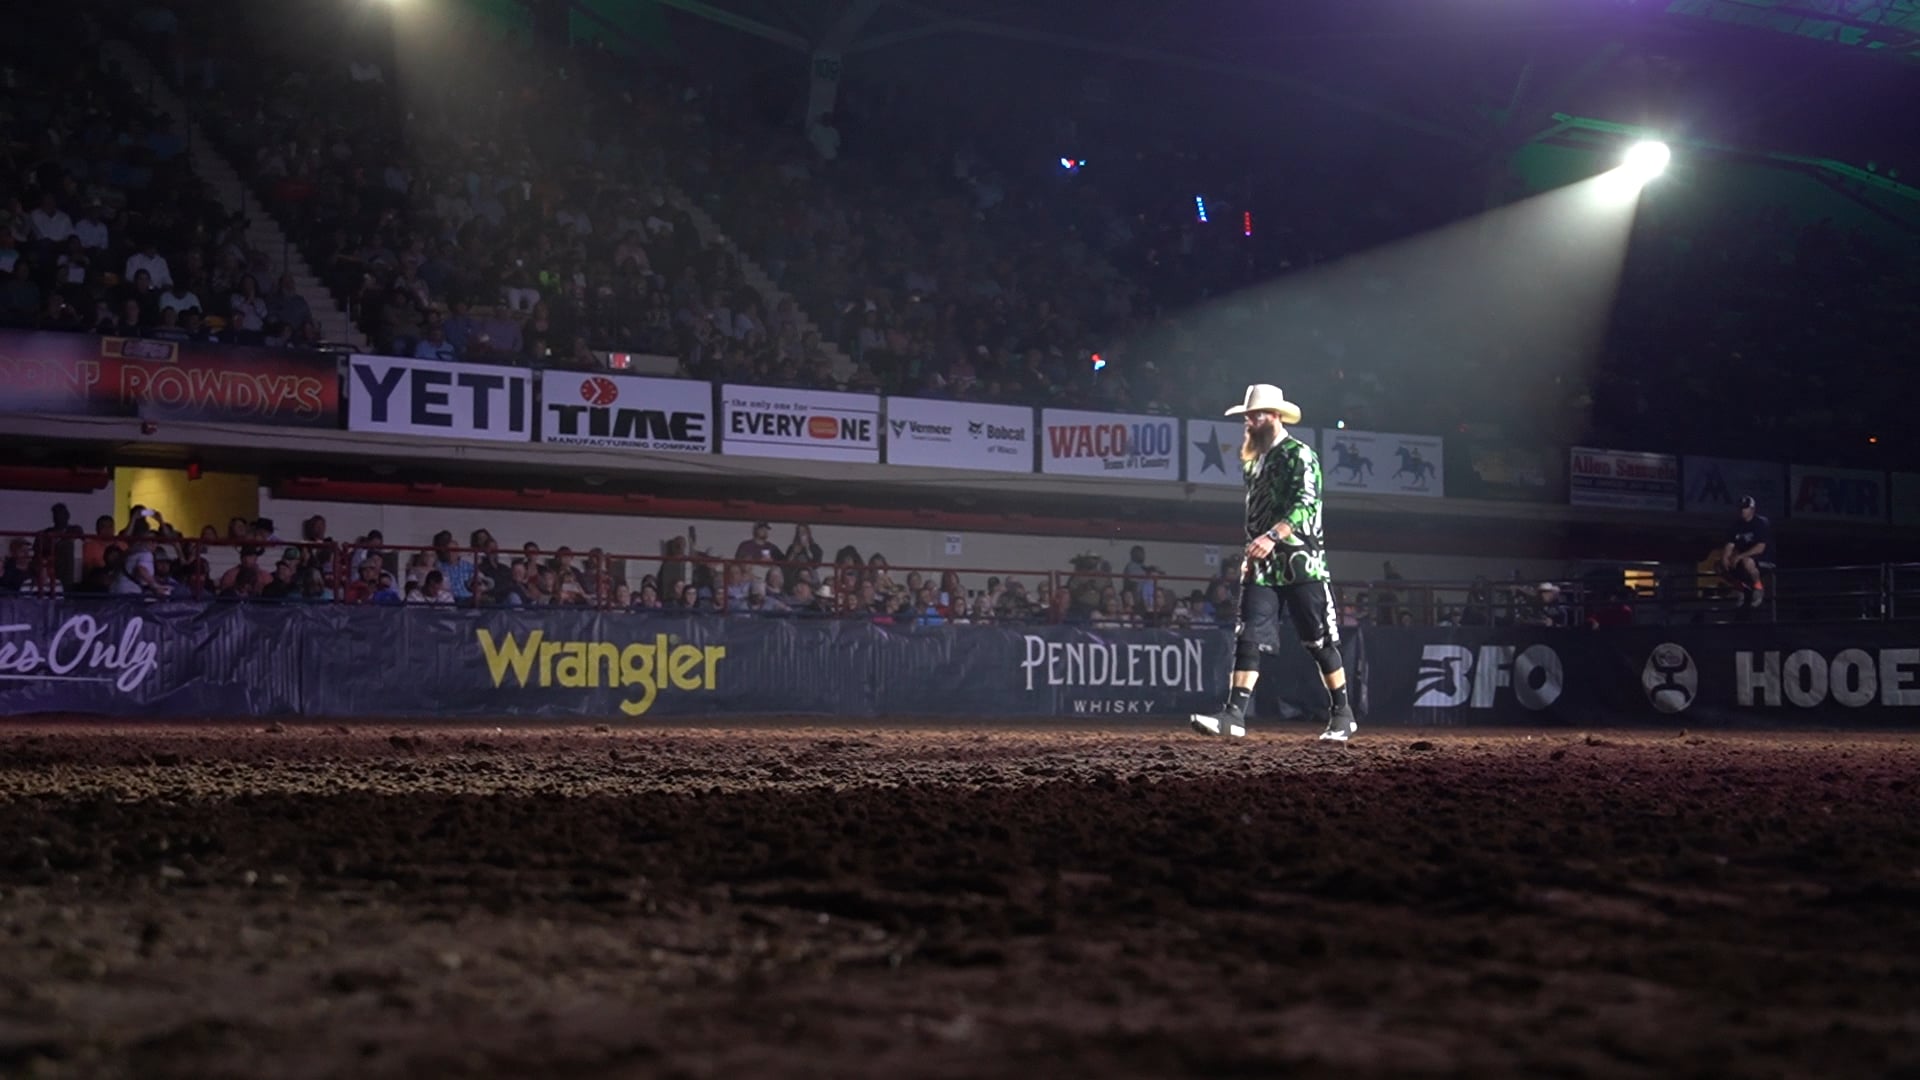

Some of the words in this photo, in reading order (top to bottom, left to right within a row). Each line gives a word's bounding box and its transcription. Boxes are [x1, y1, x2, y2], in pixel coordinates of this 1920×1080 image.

[121, 364, 323, 420] ROWDY'S
[353, 364, 525, 432] YETI
[750, 400, 771, 410] only
[549, 404, 705, 442] TIME
[909, 421, 952, 435] Vermeer
[986, 425, 1025, 441] Bobcat
[1048, 424, 1127, 458] WACO
[1131, 423, 1172, 456] 100
[547, 436, 650, 449] MANUFACTURING
[652, 442, 706, 452] COMPANY
[1573, 455, 1611, 475] Allen
[48, 614, 158, 692] Only
[1020, 635, 1205, 692] PENDLETON
[476, 628, 726, 716] Wrangler
[1413, 644, 1563, 711] BFO
[1073, 700, 1154, 713] WHISKY
